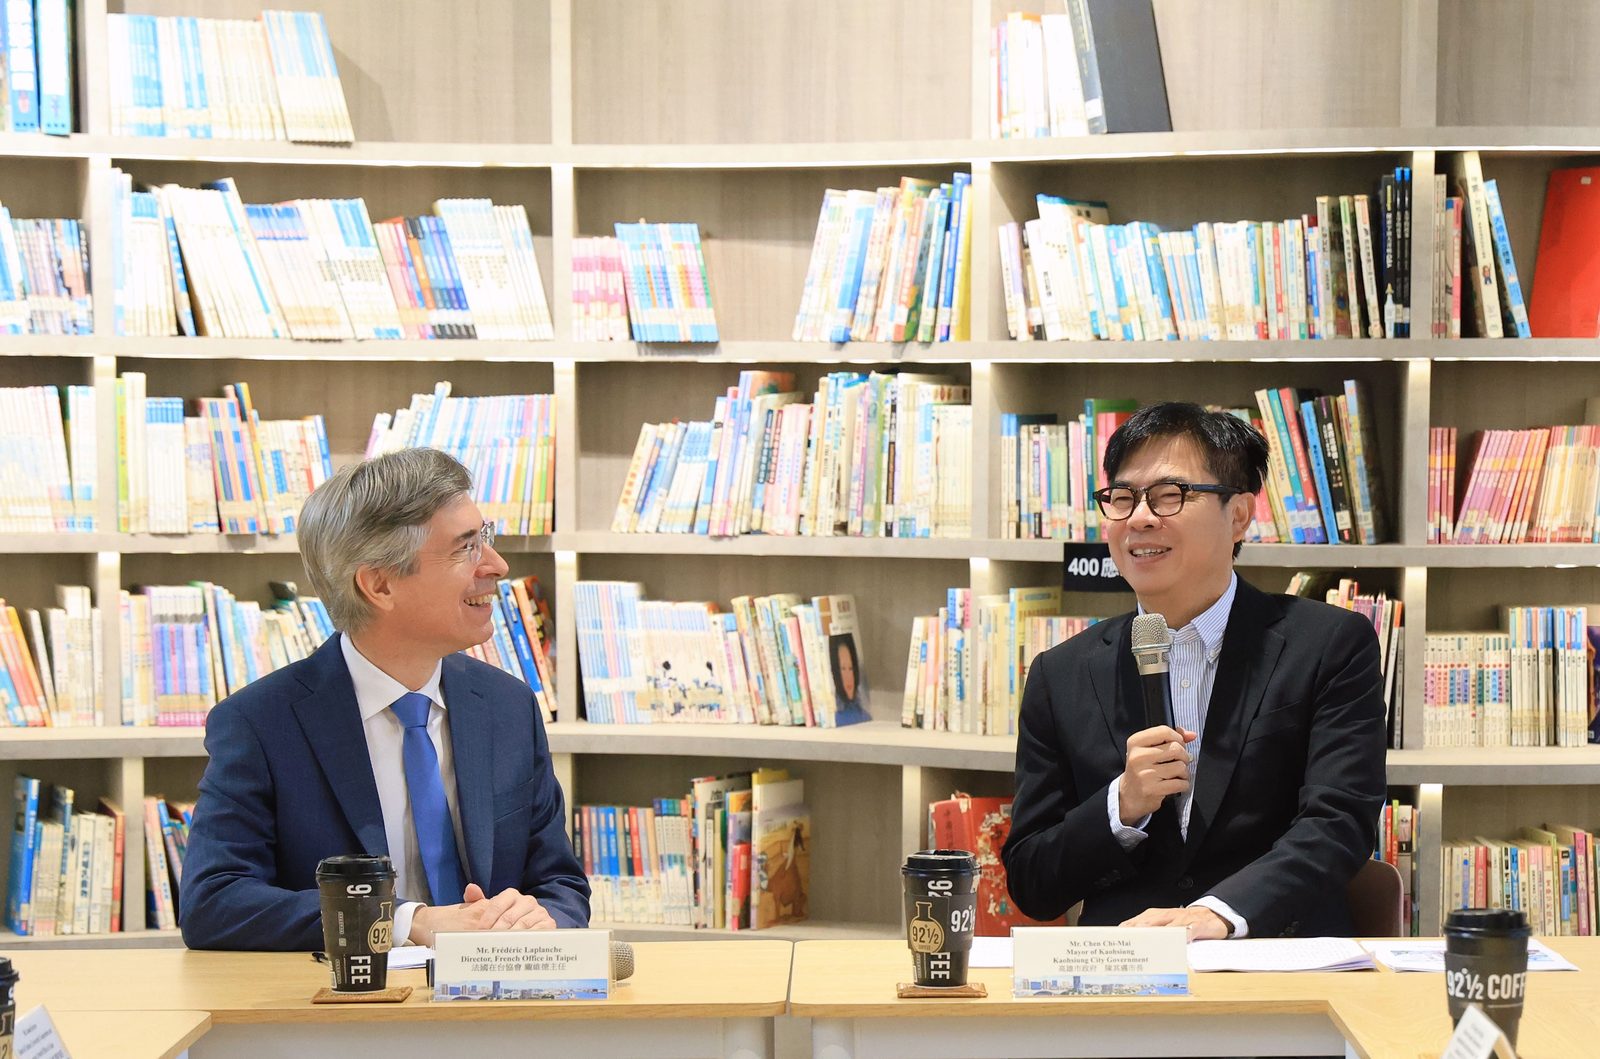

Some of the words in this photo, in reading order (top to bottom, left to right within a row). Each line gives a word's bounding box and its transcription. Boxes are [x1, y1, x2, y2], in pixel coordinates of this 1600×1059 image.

[1068, 557, 1100, 576] 400
[1070, 940, 1082, 948] Mr.
[1083, 940, 1101, 948] Chen
[1103, 940, 1132, 948] Chi-Mai
[476, 946, 489, 955] Mr.
[491, 945, 522, 955] Frédéric
[524, 945, 563, 956] Laplanche
[1066, 949, 1089, 957] Mayor
[1090, 948, 1098, 956] of
[1099, 948, 1135, 957] Kaohsiung
[460, 954, 492, 964] Director,
[494, 954, 520, 963] French
[522, 954, 544, 963] Office
[546, 954, 554, 963] in
[556, 953, 578, 963] Taipei
[1053, 956, 1089, 965] Kaohsiung
[1090, 956, 1105, 965] City
[1106, 956, 1149, 964] Government
